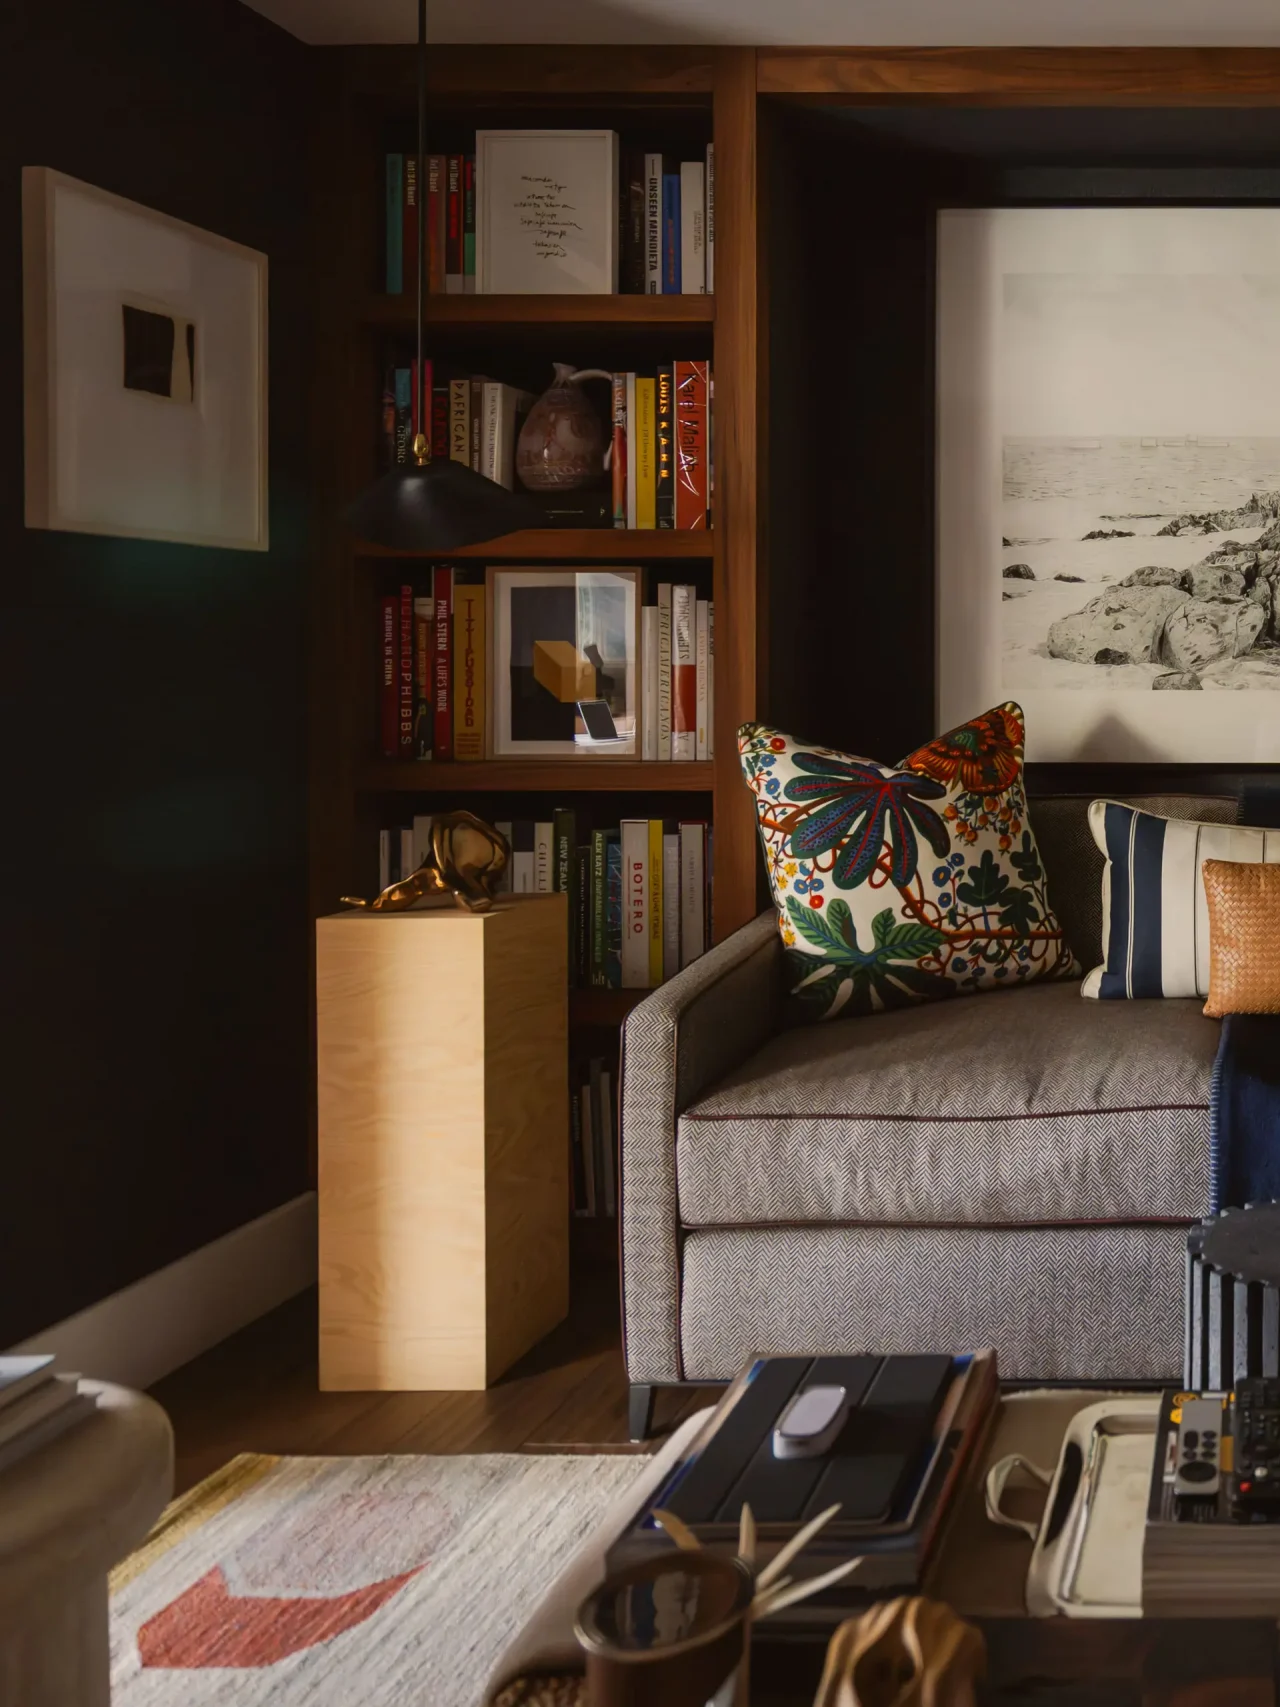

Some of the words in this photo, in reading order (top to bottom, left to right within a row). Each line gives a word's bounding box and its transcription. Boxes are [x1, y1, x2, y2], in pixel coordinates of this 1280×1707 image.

[649, 177, 659, 217] UNSEEN
[649, 219, 659, 272] MENDIETA
[659, 373, 671, 414] LOUIS
[682, 373, 702, 414] Karel
[453, 392, 464, 453] AFRICAN
[384, 606, 393, 643] WARHOL
[437, 599, 448, 620] PHIL
[384, 645, 393, 656] IN
[437, 622, 448, 651] STERN
[437, 665, 448, 688] LIFE'S
[660, 603, 670, 741] AFRICAMERICANOS
[437, 689, 448, 713] WORK
[559, 836, 569, 858] NEW
[633, 862, 643, 934] BOTERO
